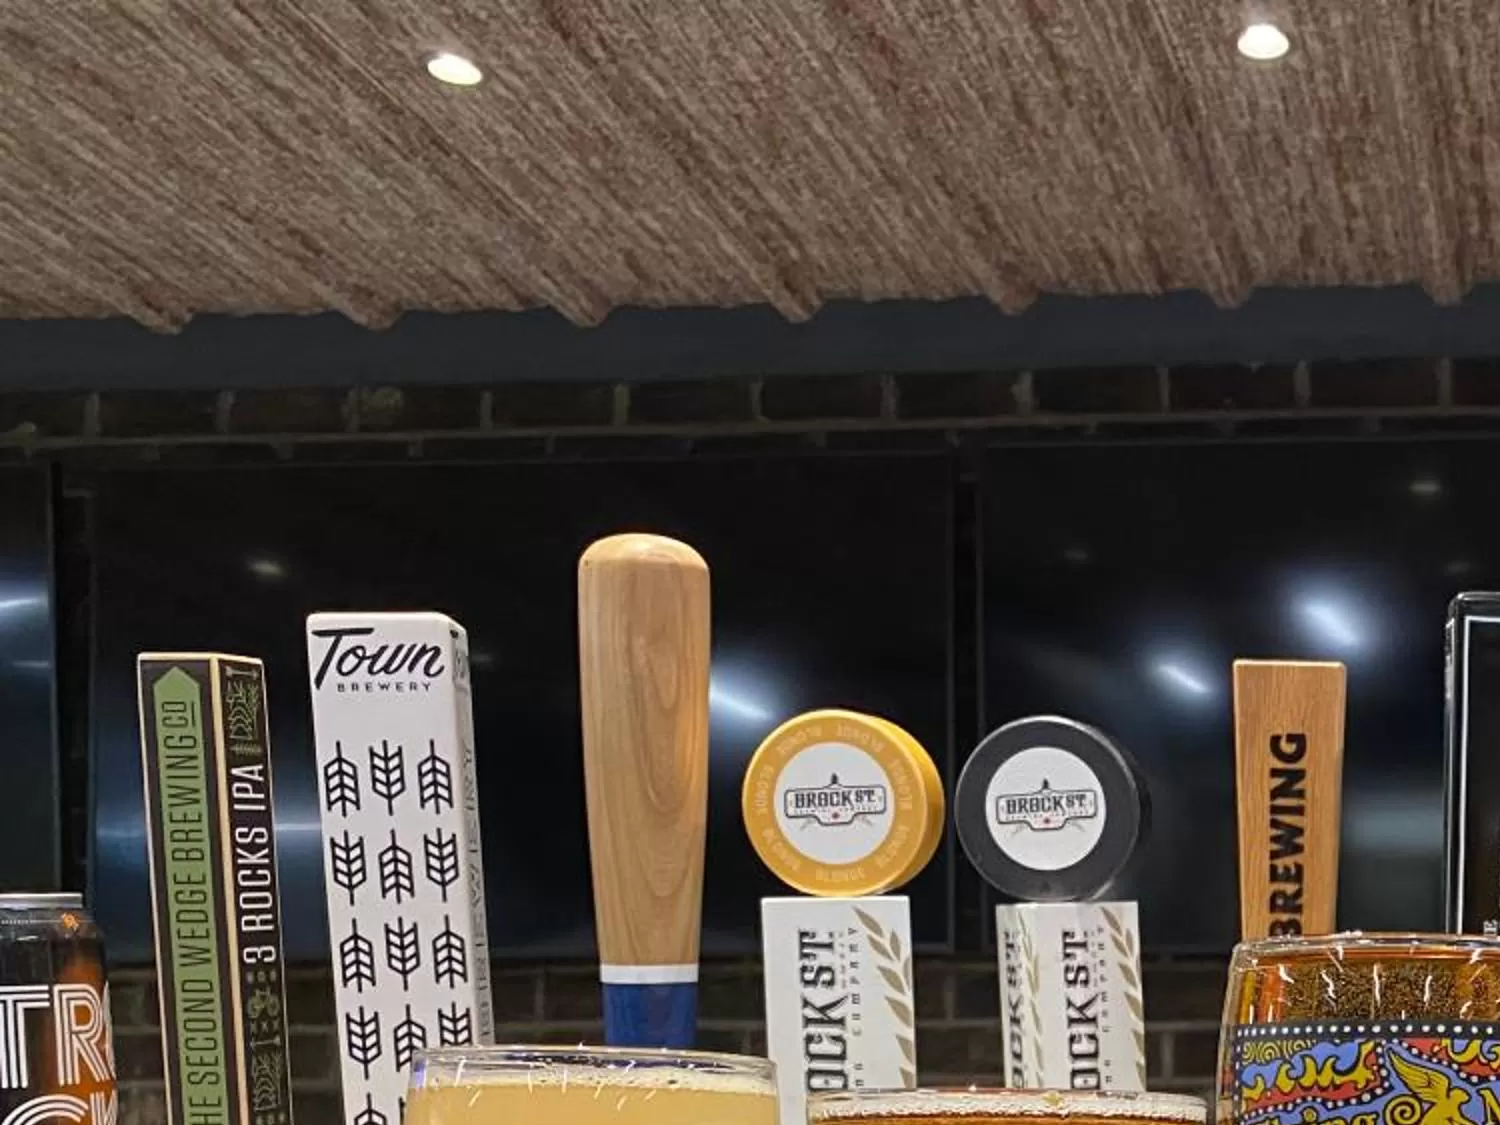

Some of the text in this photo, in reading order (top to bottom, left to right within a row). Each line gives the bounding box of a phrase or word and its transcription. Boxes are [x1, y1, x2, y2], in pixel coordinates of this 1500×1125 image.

[311, 627, 445, 691] Town
[337, 681, 431, 693] BREWERY
[161, 701, 196, 729] CO
[164, 734, 205, 863] BREWING
[795, 790, 854, 810] BROCK
[1006, 795, 1066, 815] BROCK
[1268, 732, 1307, 937] BREWING
[230, 763, 277, 964] 3 ROCKS IPA
[173, 872, 213, 968] WEDGE
[182, 978, 221, 1086] SECOND
[800, 992, 848, 1092] OCK
[1007, 993, 1025, 1089] OCK
[1066, 993, 1101, 1090] OCK
